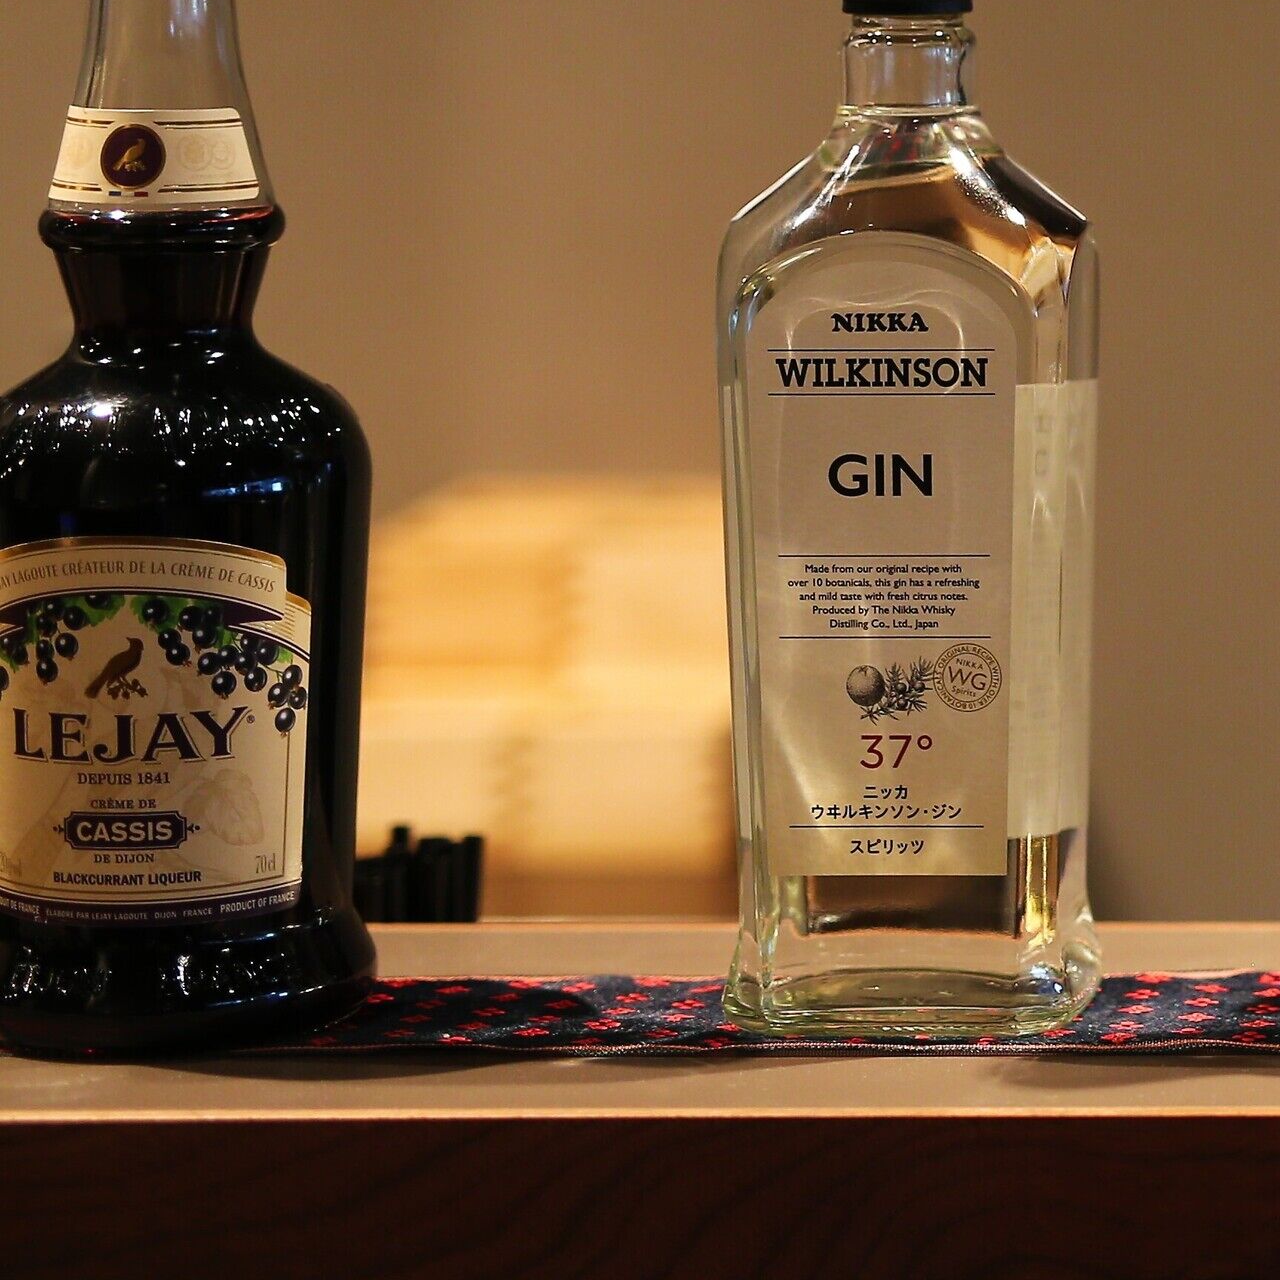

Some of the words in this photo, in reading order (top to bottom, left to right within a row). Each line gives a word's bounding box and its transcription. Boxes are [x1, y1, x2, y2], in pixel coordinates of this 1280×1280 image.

[831, 312, 929, 333] NIKKA
[775, 357, 989, 389] WILKINSON
[828, 453, 933, 497] GIN
[12, 563, 58, 585] LAGOUTE
[129, 561, 147, 574] DE
[151, 562, 166, 574] LA
[218, 568, 235, 583] DE
[238, 572, 276, 593] CASSIS
[805, 564, 829, 573] Made
[832, 564, 854, 573] from
[876, 564, 908, 575] original
[911, 564, 939, 575] recipe
[942, 564, 961, 573] with
[812, 578, 823, 587] 10
[826, 578, 872, 589] botanicals,
[875, 578, 891, 587] this
[894, 578, 906, 589] gin
[909, 578, 924, 587] has
[935, 578, 980, 589] refreshing
[799, 592, 816, 601] and
[818, 592, 837, 601] mild
[840, 592, 862, 601] taste
[864, 592, 885, 601] with
[887, 592, 909, 601] fresh
[913, 592, 937, 601] citrus
[941, 592, 968, 601] notes.
[812, 606, 855, 614] Produced
[858, 606, 869, 616] by
[871, 606, 889, 614] The
[892, 606, 918, 614] Nikka
[921, 606, 955, 616] Whisky
[830, 620, 868, 630] Distilling
[915, 620, 938, 630] Japan
[938, 646, 969, 669] ORIGINAL
[972, 647, 996, 665] RECIPE
[956, 658, 983, 670] NIKKA
[948, 666, 988, 691] WG
[859, 734, 933, 770] 37°
[77, 772, 132, 785] DEPUIS
[137, 771, 171, 785] 1841
[863, 784, 909, 800] ニッカ
[90, 796, 134, 809] CRÈME
[139, 799, 156, 809] DE
[76, 820, 173, 842] CASSIS
[850, 838, 925, 855] スピリッツ
[93, 853, 111, 864] DE
[115, 853, 155, 864] DIJON
[53, 871, 144, 886] BLACKCURRANT
[148, 871, 202, 886] LIQUEUR
[182, 907, 212, 917] FRANCE
[220, 899, 256, 914] PRODUCT
[258, 897, 267, 908] OF
[268, 890, 296, 905] FRANCE
